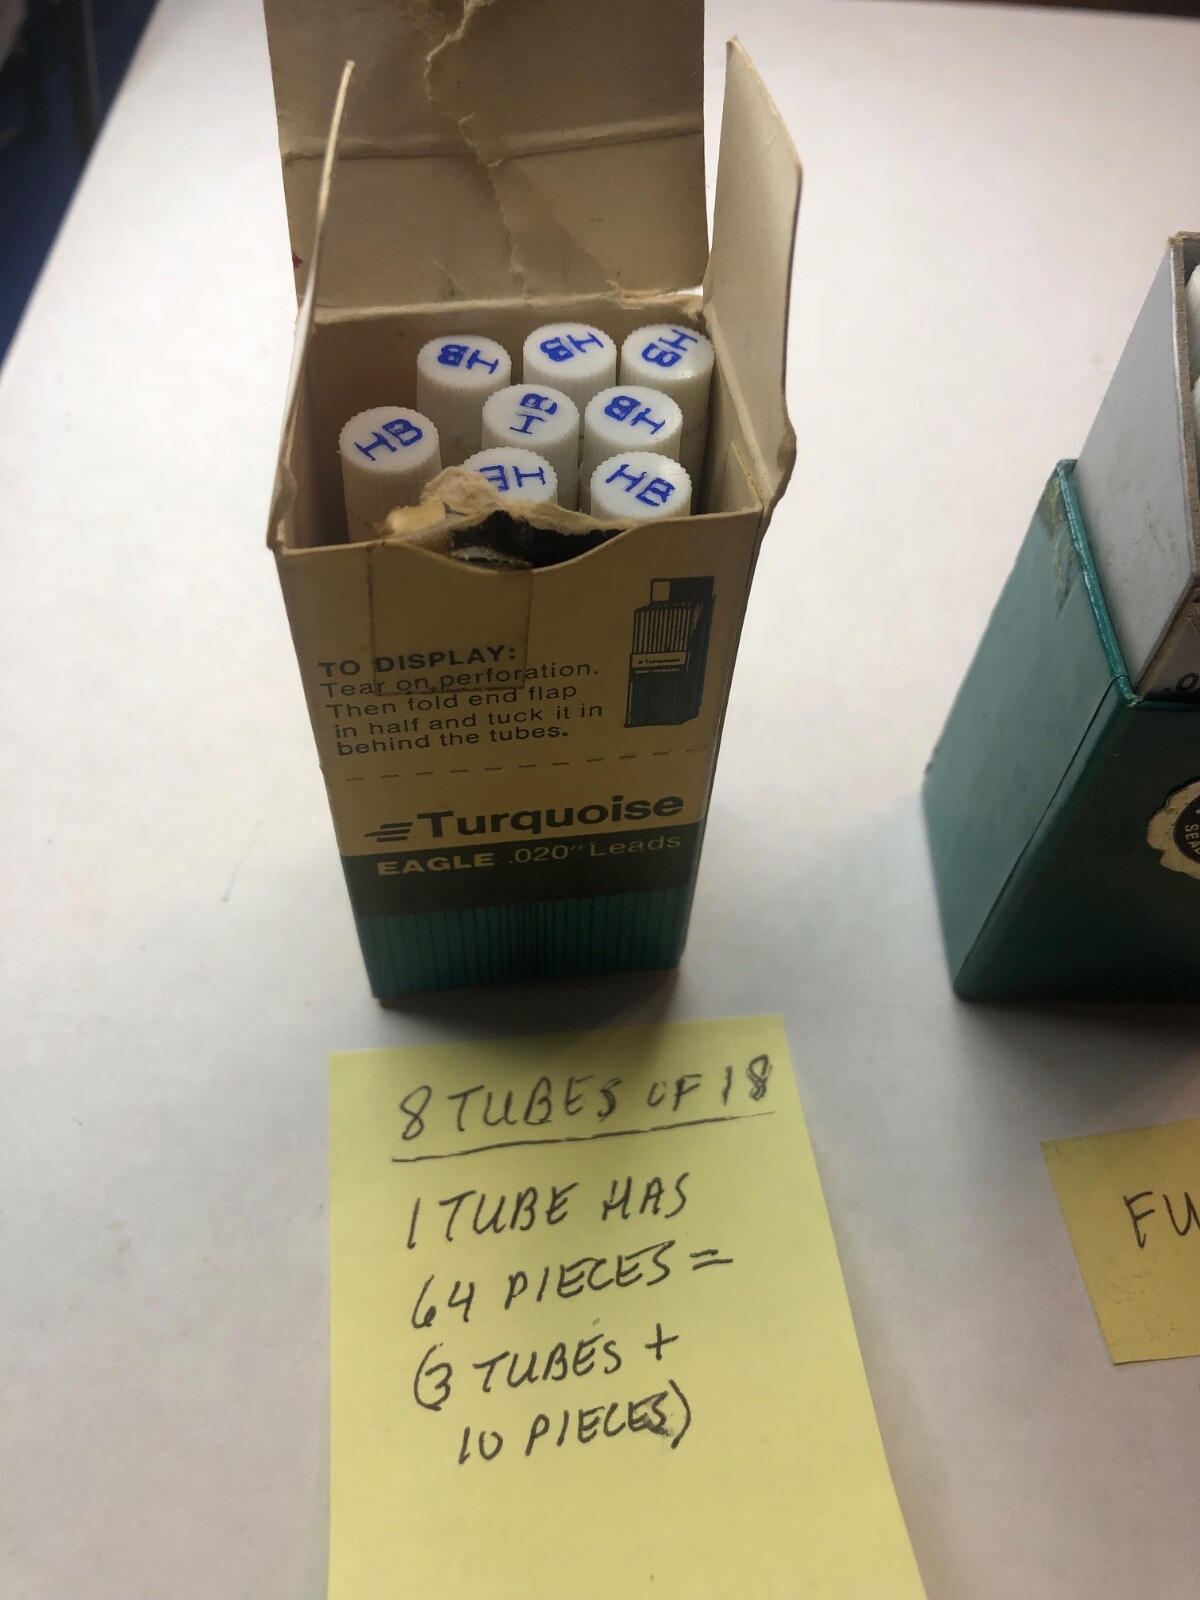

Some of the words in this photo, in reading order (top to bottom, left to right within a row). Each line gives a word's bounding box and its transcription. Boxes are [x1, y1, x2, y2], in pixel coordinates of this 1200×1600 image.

[437, 344, 499, 375] HB
[540, 331, 604, 362] HB
[641, 328, 698, 368] HB
[509, 393, 558, 435] HB
[604, 395, 666, 435] HB
[354, 418, 423, 461] HB
[605, 463, 676, 507] HB
[318, 660, 360, 677] TO
[374, 644, 515, 673] DISPLAY:
[320, 682, 386, 698] Tear
[396, 677, 429, 691] on
[440, 662, 599, 690] perforation.
[326, 703, 396, 718] Then
[408, 694, 457, 712] fold
[469, 688, 517, 706] end
[528, 685, 577, 700] flap
[335, 724, 357, 738] in
[369, 718, 418, 735] half
[429, 713, 476, 731] and
[488, 708, 543, 725] tuck
[556, 705, 570, 720] it
[580, 703, 602, 718] in
[337, 735, 430, 756] behind
[440, 730, 480, 747] the
[490, 726, 568, 742] tubes.
[416, 795, 684, 838] Turquoise
[377, 852, 495, 876] EAGLE
[590, 835, 682, 857] Leads
[399, 1085, 433, 1141] 8
[447, 1075, 621, 1132] TUBES
[646, 1074, 702, 1111] OF
[722, 1054, 773, 1106] 18
[407, 1197, 421, 1250] 1
[439, 1182, 579, 1241] TUBE
[601, 1172, 690, 1221] HAS
[411, 1274, 475, 1329] 64
[504, 1240, 676, 1310] PIECES
[473, 1333, 622, 1393] TUBES
[458, 1426, 503, 1465] 10
[525, 1379, 691, 1456] PIECES)
